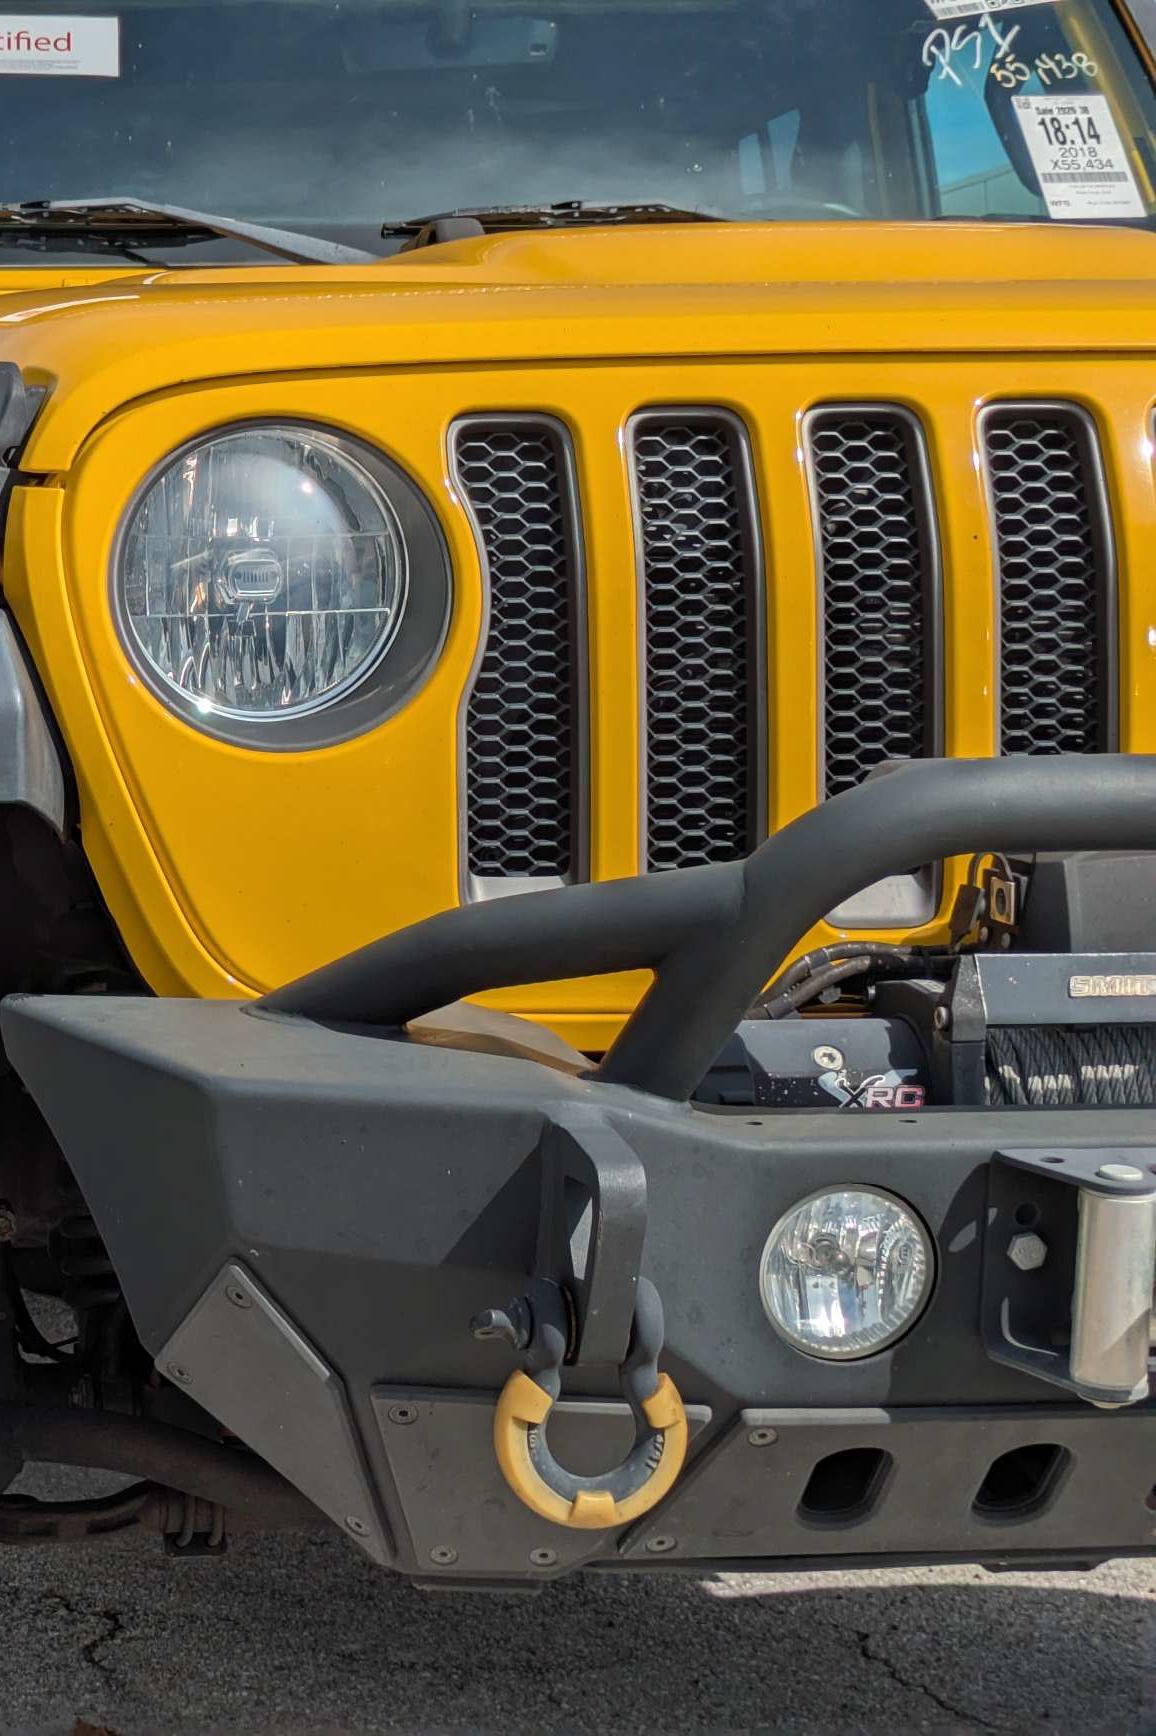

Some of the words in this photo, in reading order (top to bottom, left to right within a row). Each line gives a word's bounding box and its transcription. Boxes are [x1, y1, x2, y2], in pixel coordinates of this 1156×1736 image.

[1037, 116, 1101, 146] 18:14
[1058, 146, 1098, 159] 2018
[1050, 159, 1114, 172] X55,434
